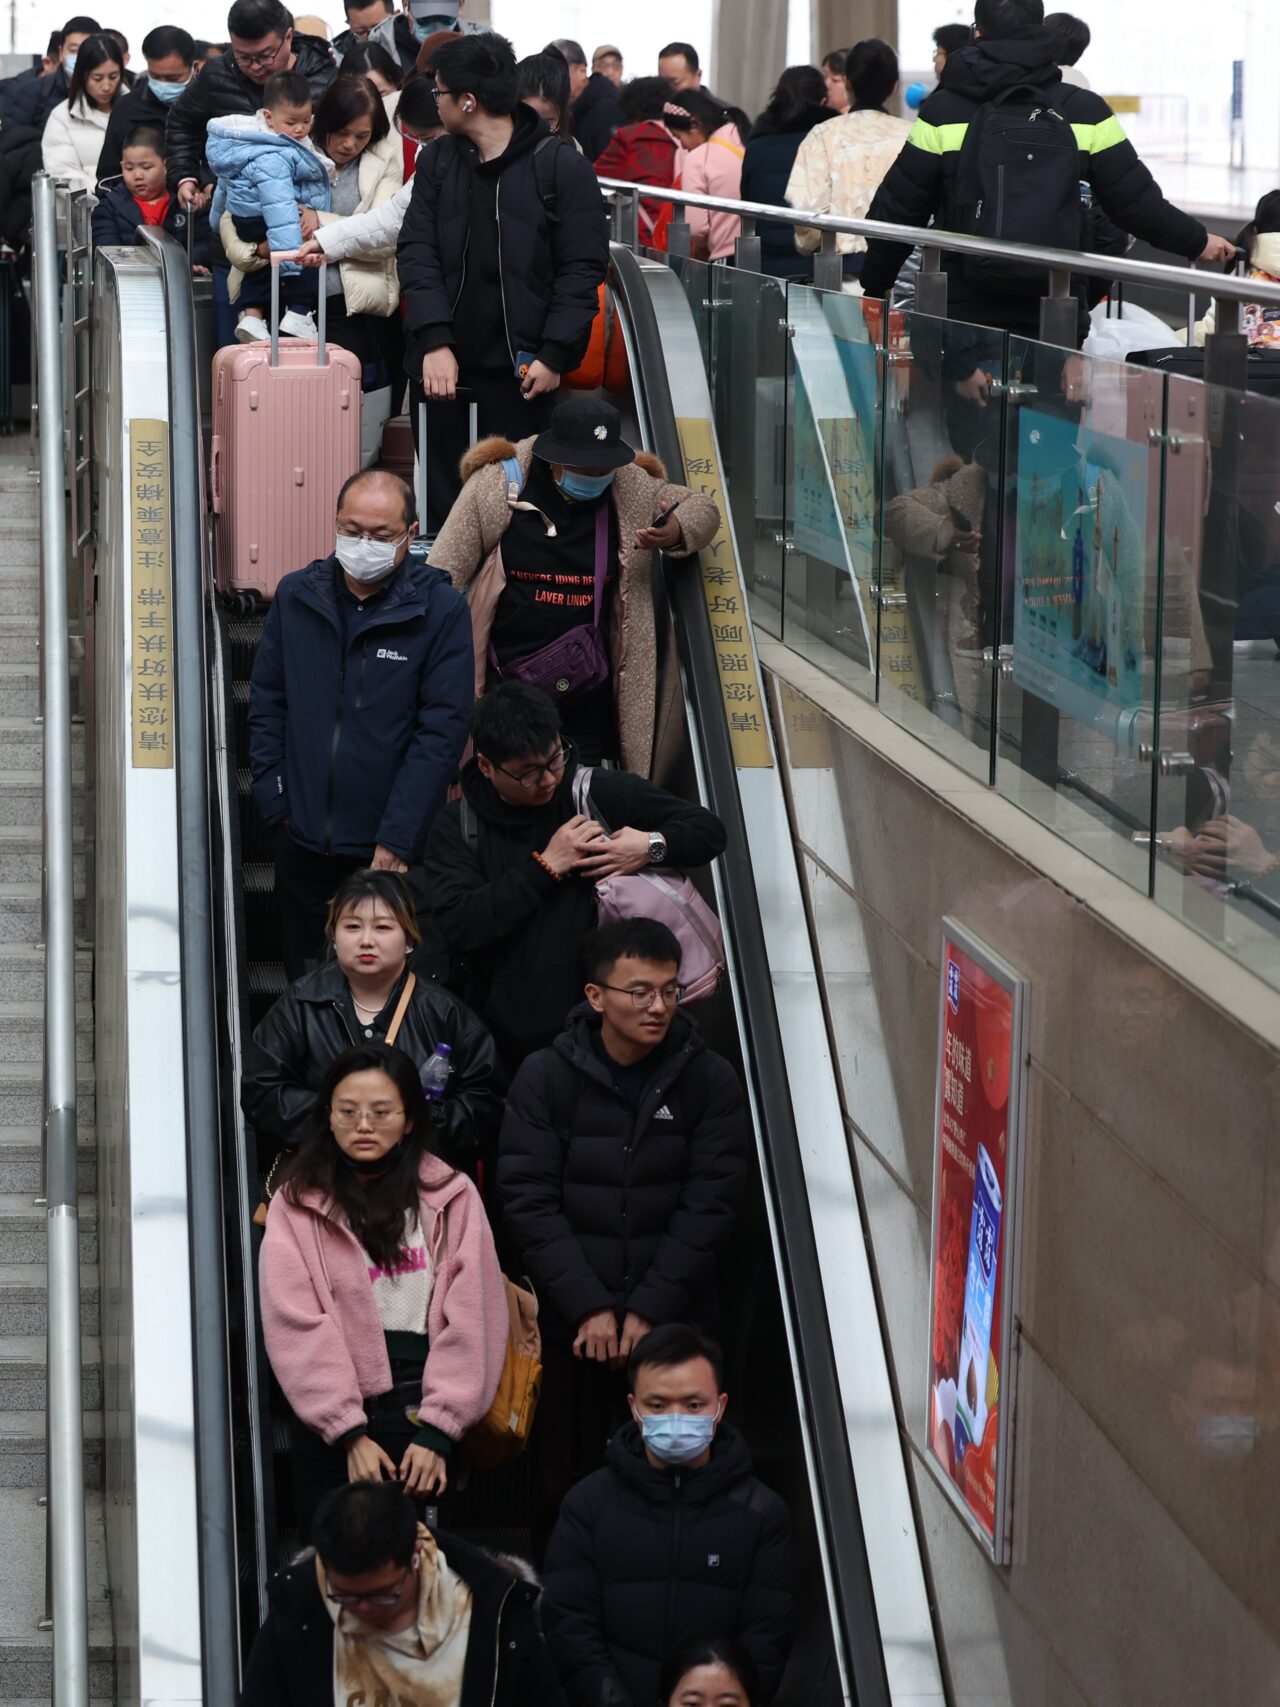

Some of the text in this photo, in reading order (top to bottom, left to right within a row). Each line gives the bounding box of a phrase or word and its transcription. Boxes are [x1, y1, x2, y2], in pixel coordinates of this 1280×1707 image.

[135, 440, 169, 751] 请您扶好扶手带 注意乘梯安全
[685, 458, 761, 734] 请您照顾好老人孩
